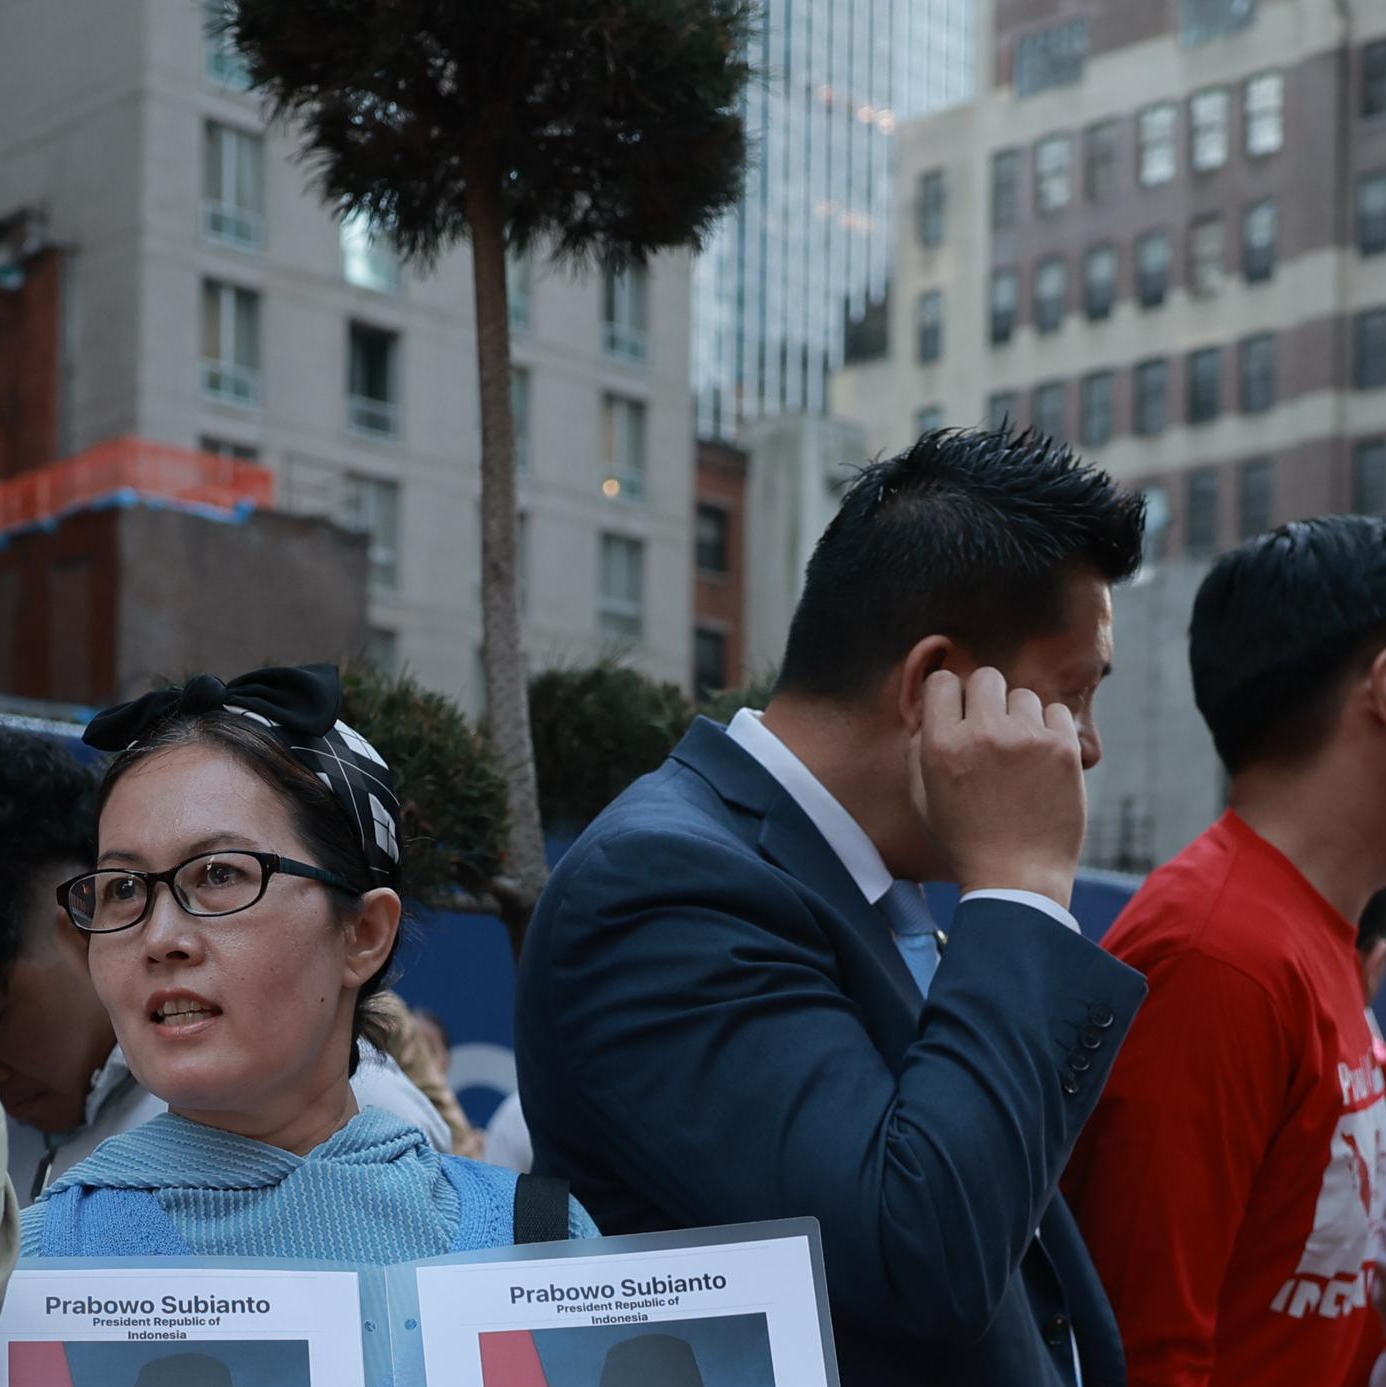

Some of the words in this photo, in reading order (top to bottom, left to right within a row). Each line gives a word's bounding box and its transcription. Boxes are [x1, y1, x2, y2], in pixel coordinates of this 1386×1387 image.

[509, 1284, 615, 1304] Prabowo
[620, 1274, 727, 1298] Subianto
[45, 1296, 154, 1315] Prabowo
[160, 1295, 271, 1314] Subianto
[556, 1302, 613, 1314] President
[614, 1297, 666, 1310] Republic
[668, 1296, 680, 1306] of
[92, 1317, 151, 1327] President
[153, 1316, 206, 1328] Republic
[208, 1316, 221, 1326] of
[591, 1312, 649, 1325] Indonesia
[127, 1330, 187, 1340] Indonesia
